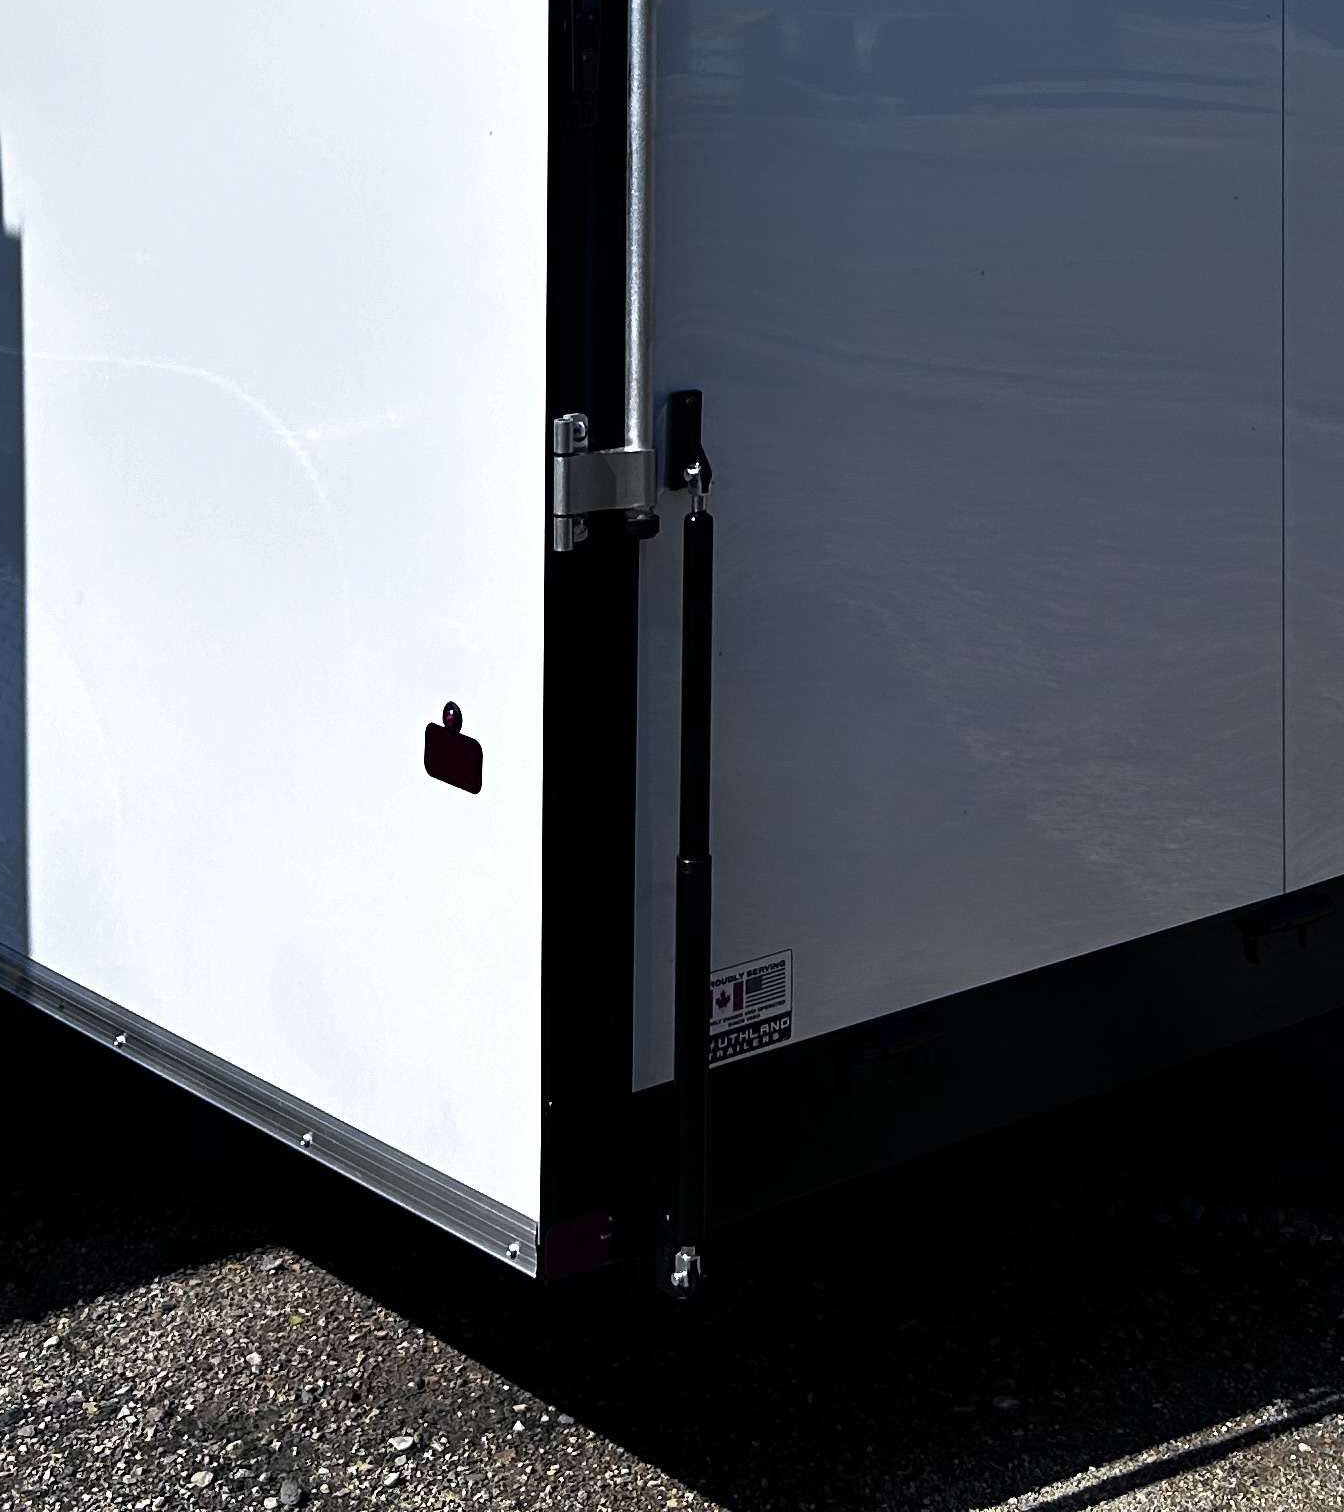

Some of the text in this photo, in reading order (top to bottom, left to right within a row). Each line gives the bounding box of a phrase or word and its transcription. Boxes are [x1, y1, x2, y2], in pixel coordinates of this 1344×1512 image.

[711, 960, 786, 988] OUDLY SERVING
[710, 1016, 790, 1049] UTHLAND
